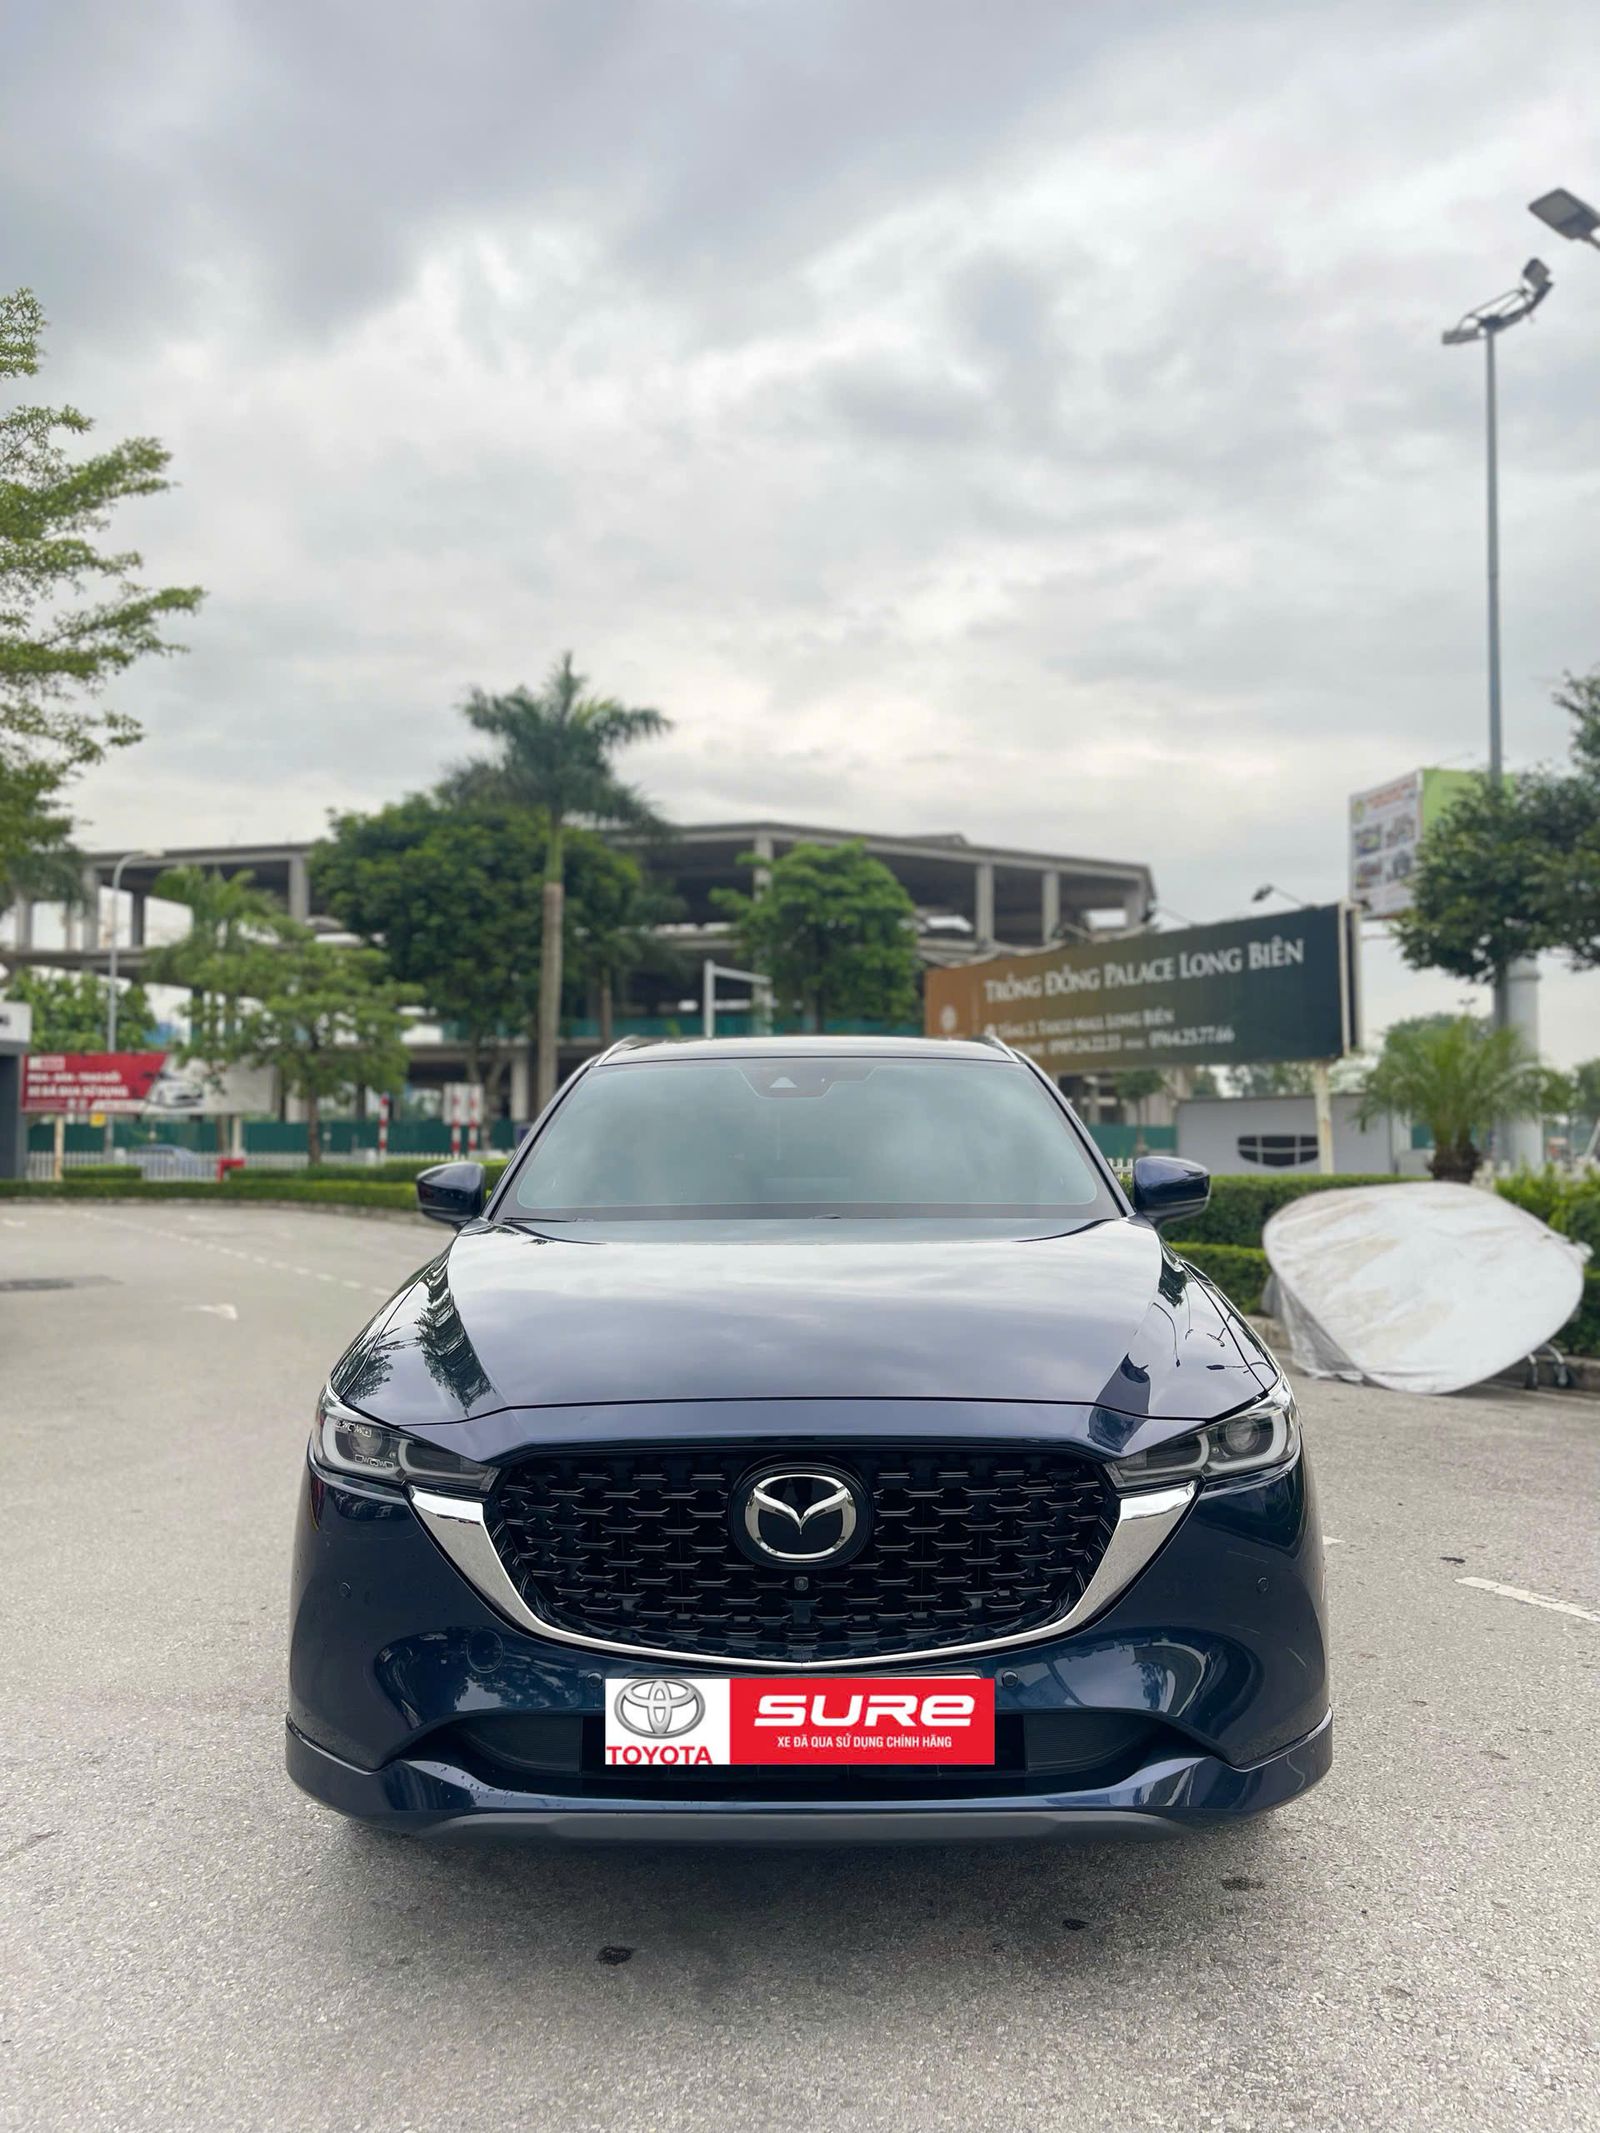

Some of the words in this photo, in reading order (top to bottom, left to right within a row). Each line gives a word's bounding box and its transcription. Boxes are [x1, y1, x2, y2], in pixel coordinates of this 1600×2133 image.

[1103, 957, 1175, 988] PALACE
[1179, 948, 1243, 979] LONG
[1248, 935, 1304, 970] BIÊN
